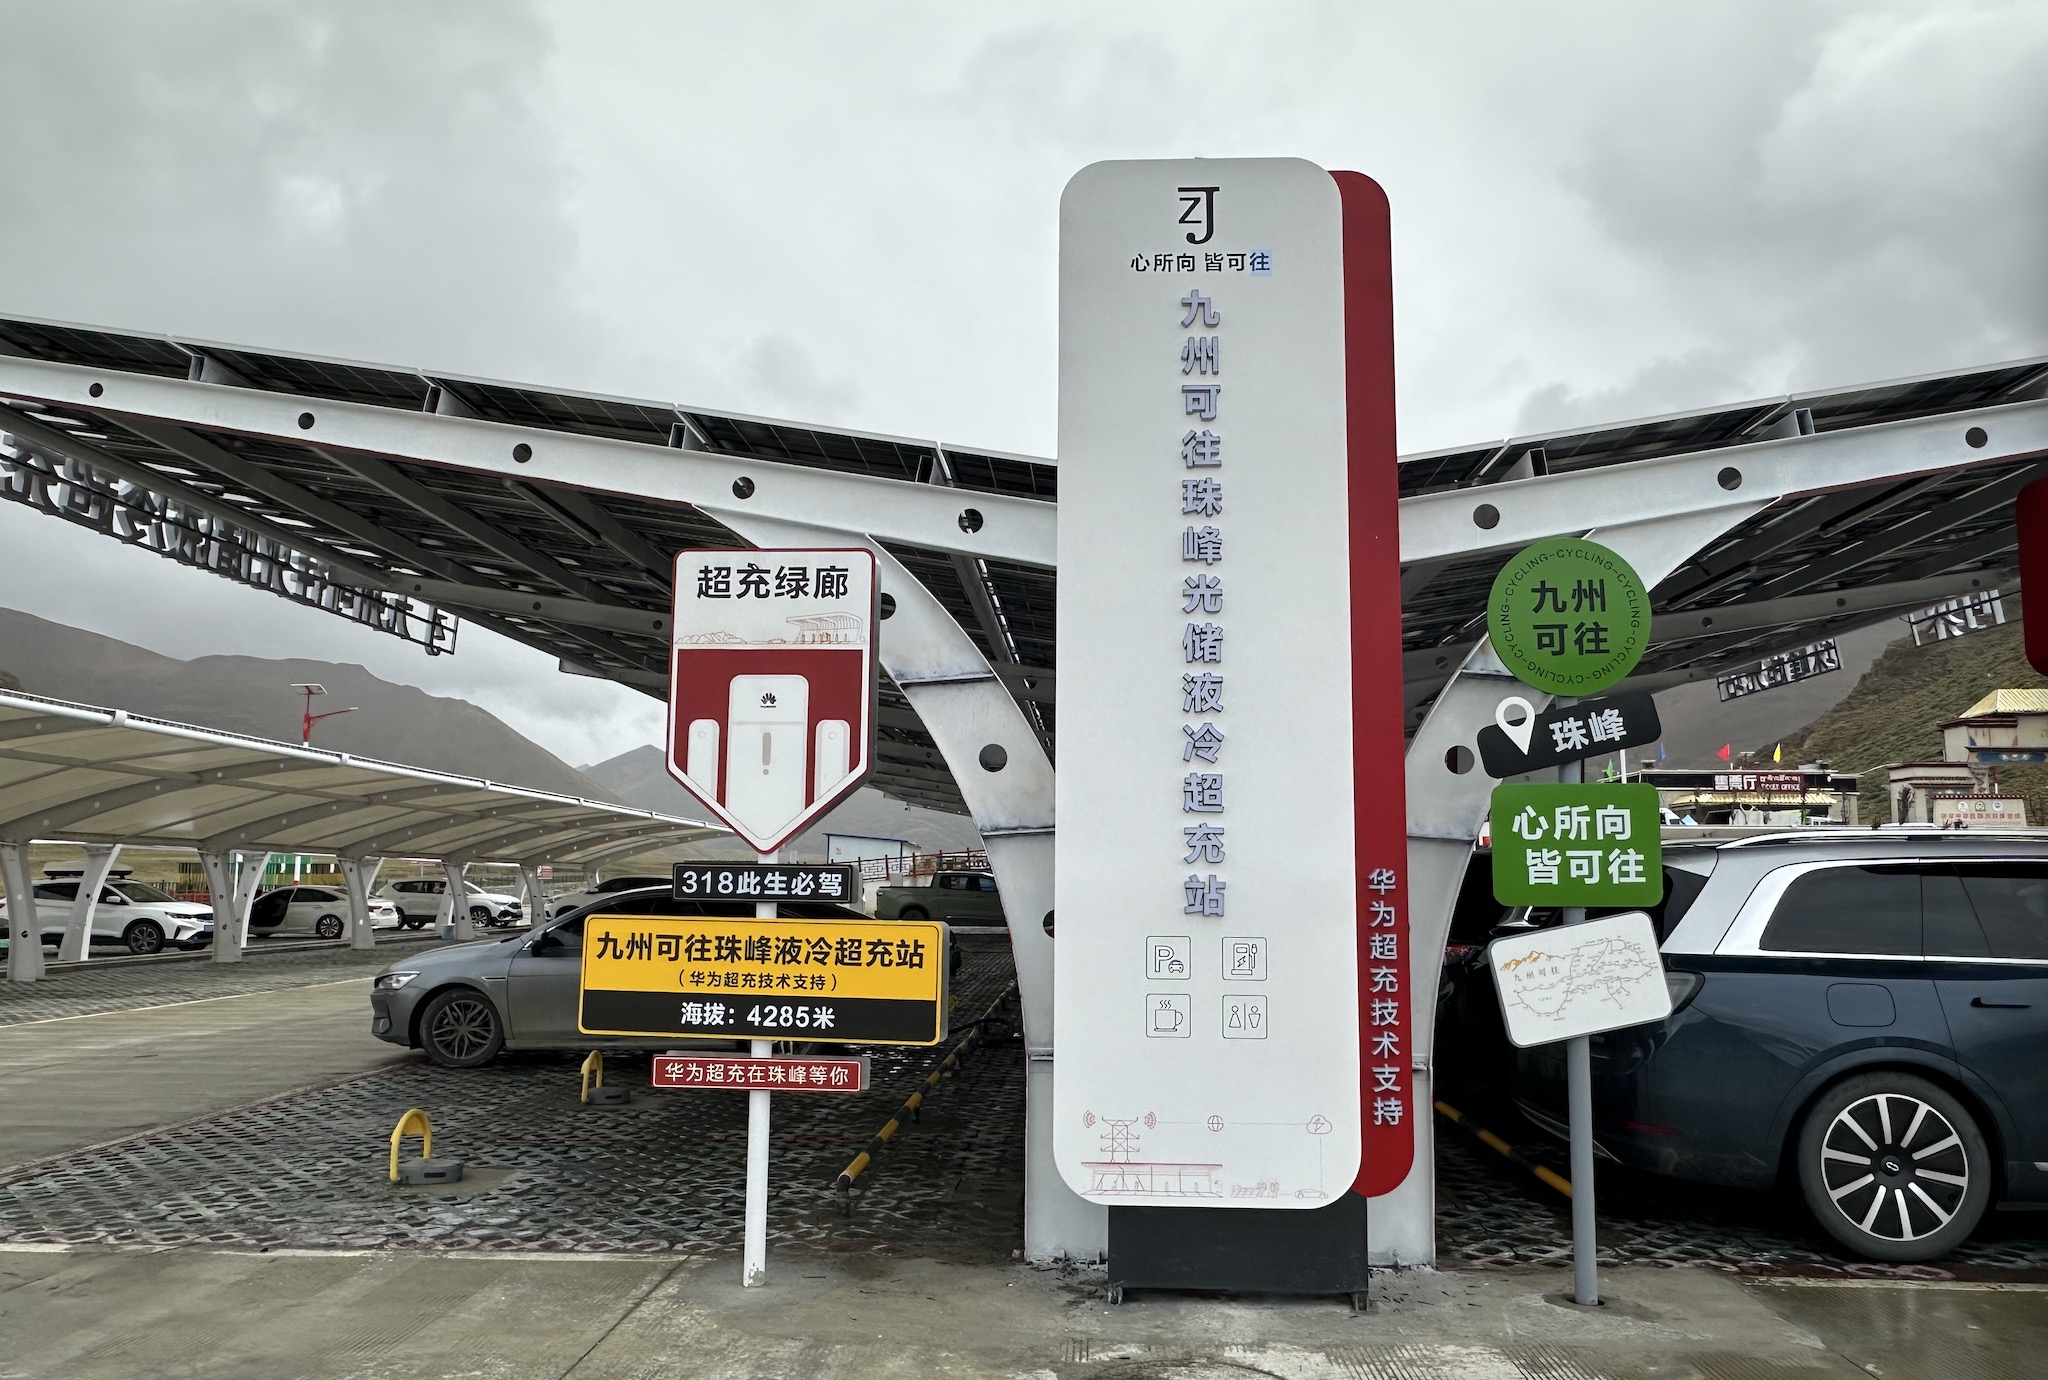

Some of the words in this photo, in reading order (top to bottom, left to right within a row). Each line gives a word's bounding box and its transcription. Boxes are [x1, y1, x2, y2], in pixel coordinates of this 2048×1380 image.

[1130, 253, 1196, 273] 心所向
[1204, 253, 1271, 273] 皆可往
[696, 563, 849, 600] 超充绿廊
[1530, 579, 1607, 615] 九州
[1180, 289, 1226, 917] 九州可往珠峰光储液冷超充站
[1532, 621, 1610, 657] 可往
[1549, 708, 1627, 753] 珠峰
[1714, 775, 1757, 790] 售票厅
[1512, 805, 1631, 841] 心所向
[682, 871, 842, 897] 318此生必驾
[1526, 848, 1646, 886] 皆可往
[596, 932, 925, 969] 九州可往珠峰液冷超充站
[1368, 868, 1403, 1126] 华为超充技术支持
[665, 1062, 849, 1086] 华为超充在珠峰等你
